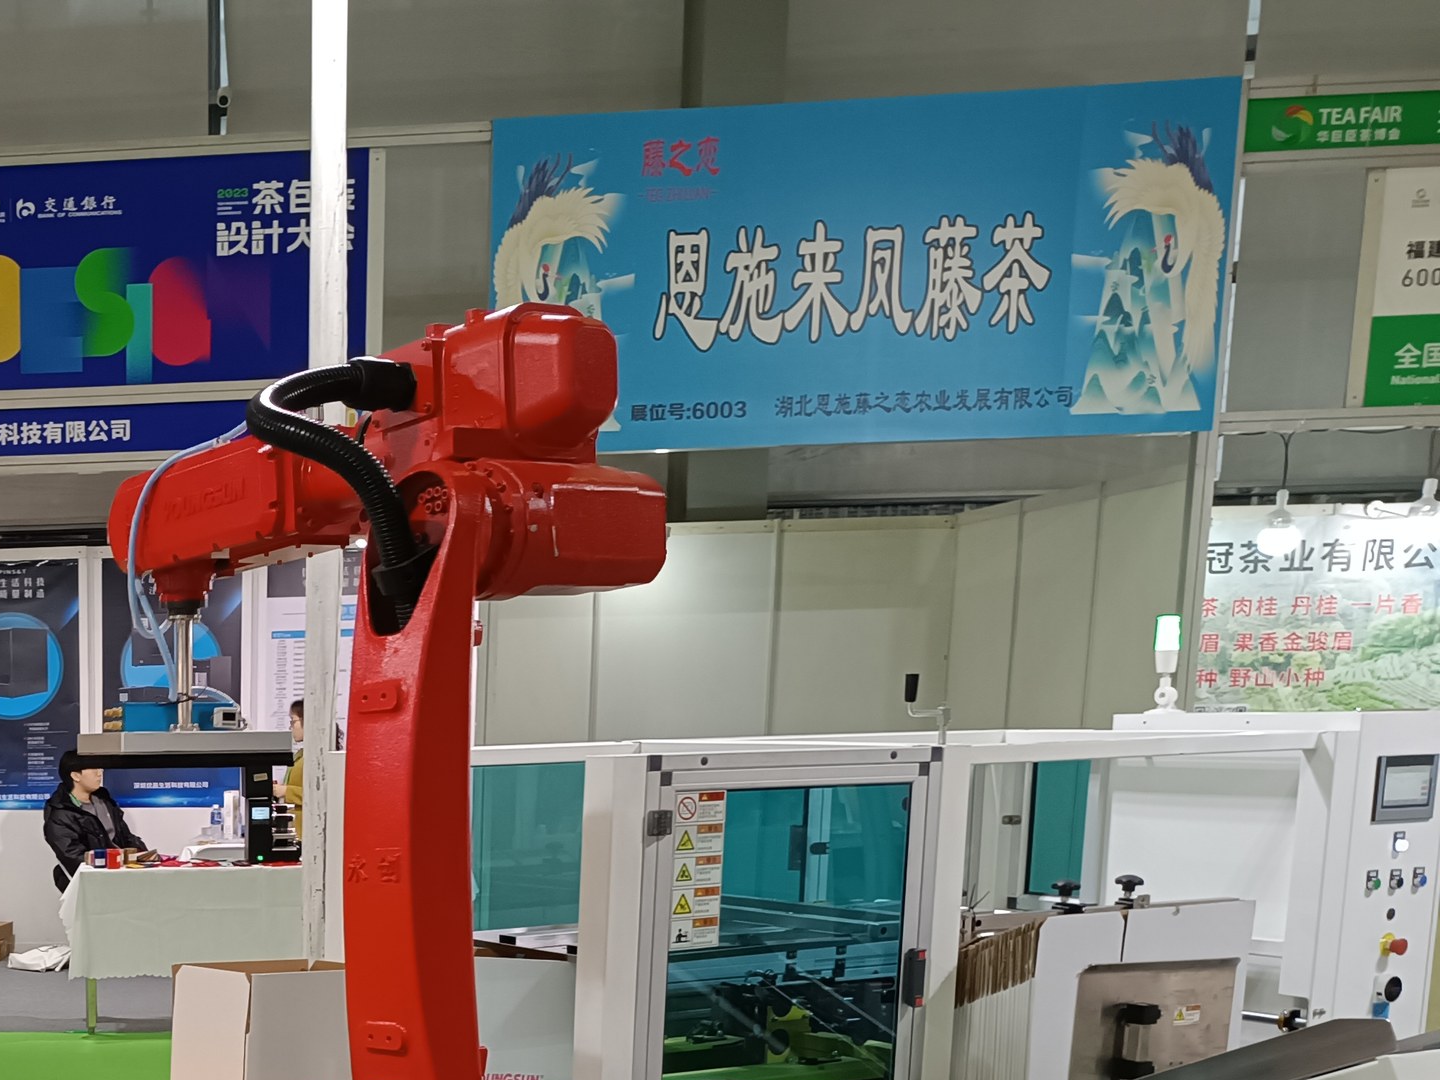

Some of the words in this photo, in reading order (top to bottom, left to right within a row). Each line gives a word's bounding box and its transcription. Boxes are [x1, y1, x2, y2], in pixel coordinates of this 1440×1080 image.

[1319, 107, 1356, 125] TEA
[1359, 105, 1402, 123] FAIR
[216, 188, 249, 199] 2023
[216, 218, 355, 256] 設計大
[653, 212, 1052, 352] 恩施来凤藤茶
[1231, 596, 1278, 618] 肉桂
[1291, 595, 1338, 616] 丹桂
[1351, 593, 1423, 615] 一片香
[1200, 633, 1220, 653] 眉
[1195, 669, 1218, 689] 种
[1229, 667, 1325, 689] 野山小种
